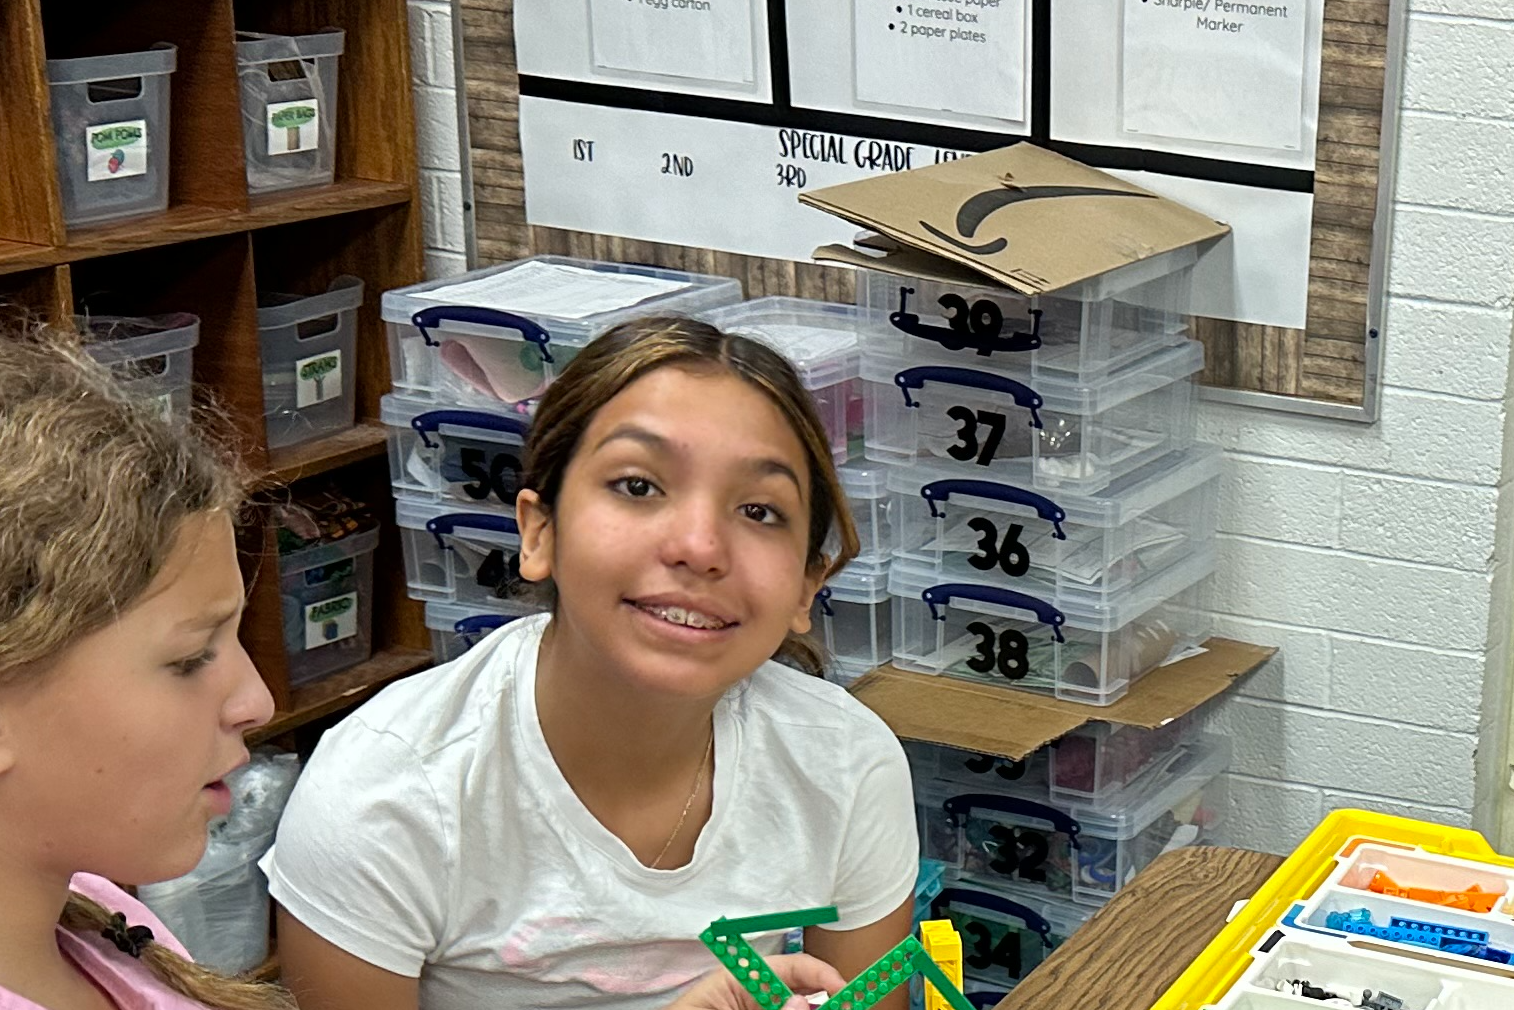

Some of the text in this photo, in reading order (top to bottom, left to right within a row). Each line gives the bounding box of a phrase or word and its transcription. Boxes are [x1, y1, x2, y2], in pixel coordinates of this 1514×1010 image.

[671, 0, 711, 11] carton
[907, 4, 979, 23] 1 cereal box
[1214, 0, 1288, 18] Permanent
[900, 20, 987, 43] 2 paper plates
[1196, 16, 1244, 33] Marker
[778, 128, 847, 165] SPECIAL
[661, 152, 694, 177] 2ND
[776, 163, 807, 188] 3RD
[946, 405, 1007, 466] 37
[460, 447, 523, 505] 50
[967, 517, 1030, 578] 36
[966, 621, 1030, 681] 38
[989, 824, 1049, 883] 32
[965, 920, 1023, 980] 34
